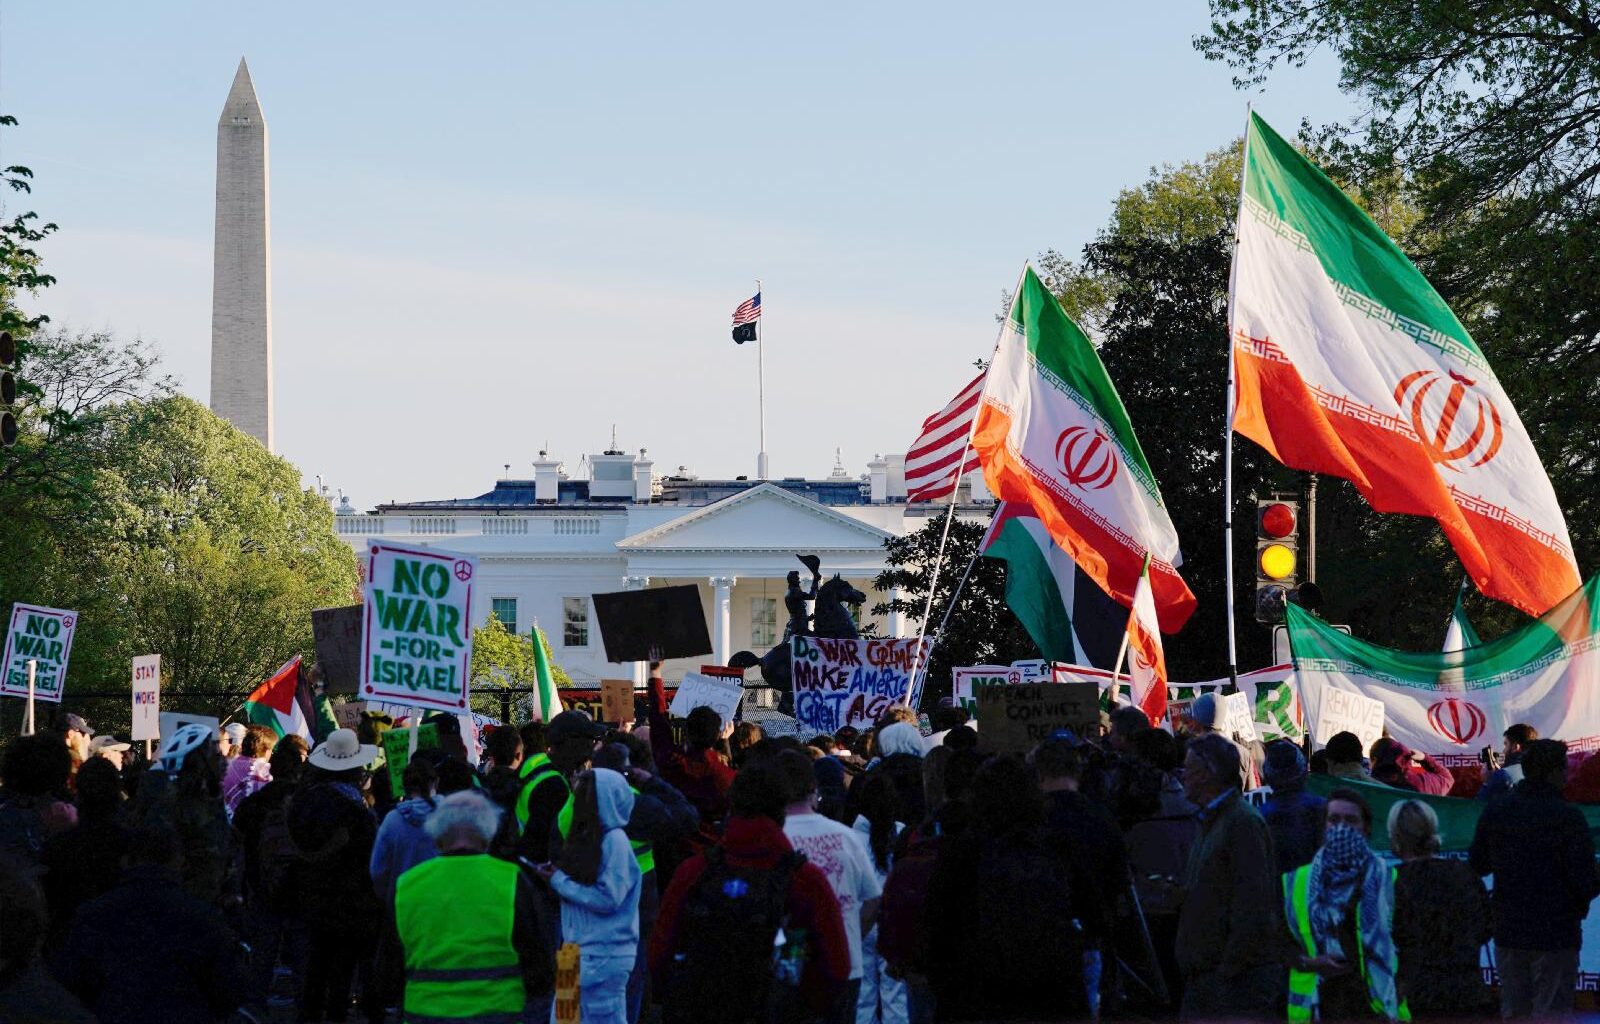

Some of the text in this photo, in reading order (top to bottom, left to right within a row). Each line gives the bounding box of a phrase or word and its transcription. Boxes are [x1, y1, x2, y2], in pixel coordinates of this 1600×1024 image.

[393, 559, 450, 600] NO
[25, 614, 61, 639] NO
[374, 589, 465, 648] WAR
[14, 631, 63, 665] WAR
[815, 637, 862, 667] WAR
[866, 638, 929, 673] CRIMES
[135, 665, 156, 681] STAY
[373, 654, 462, 695] ISRAEL
[704, 672, 742, 687] UMP
[793, 660, 850, 692] MAKE
[134, 691, 156, 705] WOKE
[1327, 687, 1382, 728] REMOVE
[1027, 721, 1099, 740] REOVE
[1322, 718, 1374, 746] TRP
